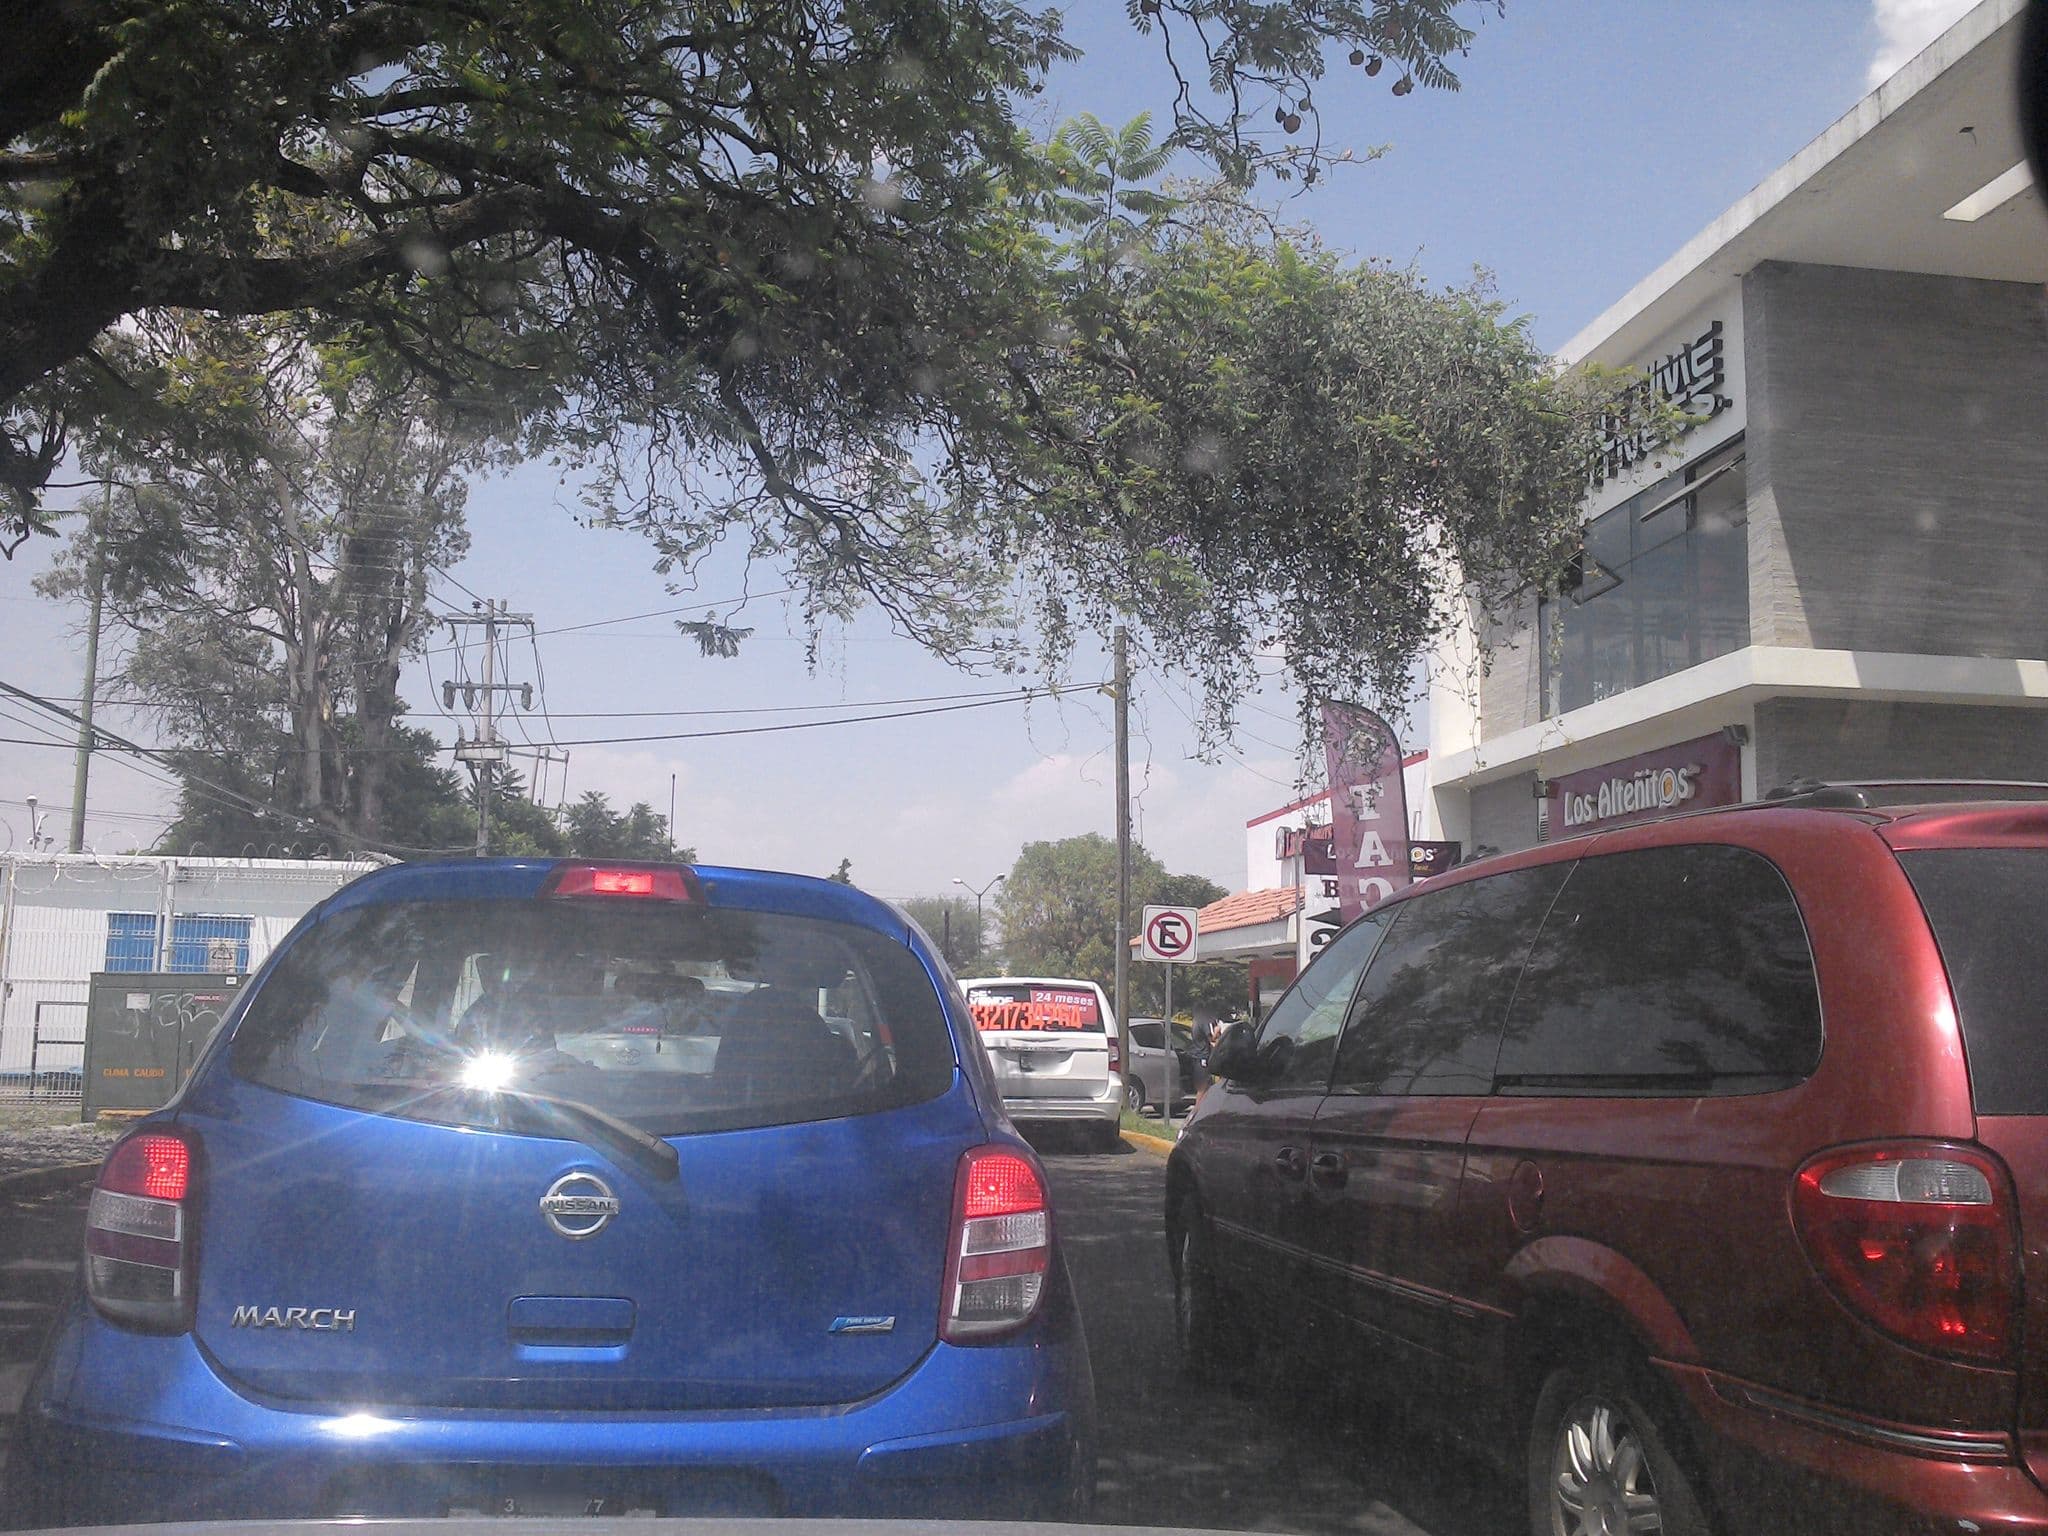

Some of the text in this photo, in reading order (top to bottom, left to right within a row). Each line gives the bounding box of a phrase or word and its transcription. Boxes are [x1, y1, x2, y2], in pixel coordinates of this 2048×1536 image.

[1564, 791, 1594, 826] Los
[1160, 920, 1181, 949] E
[1035, 992, 1094, 1006] 24 meses
[544, 1199, 611, 1211] NISSAN
[231, 1305, 356, 1331] MARCH
